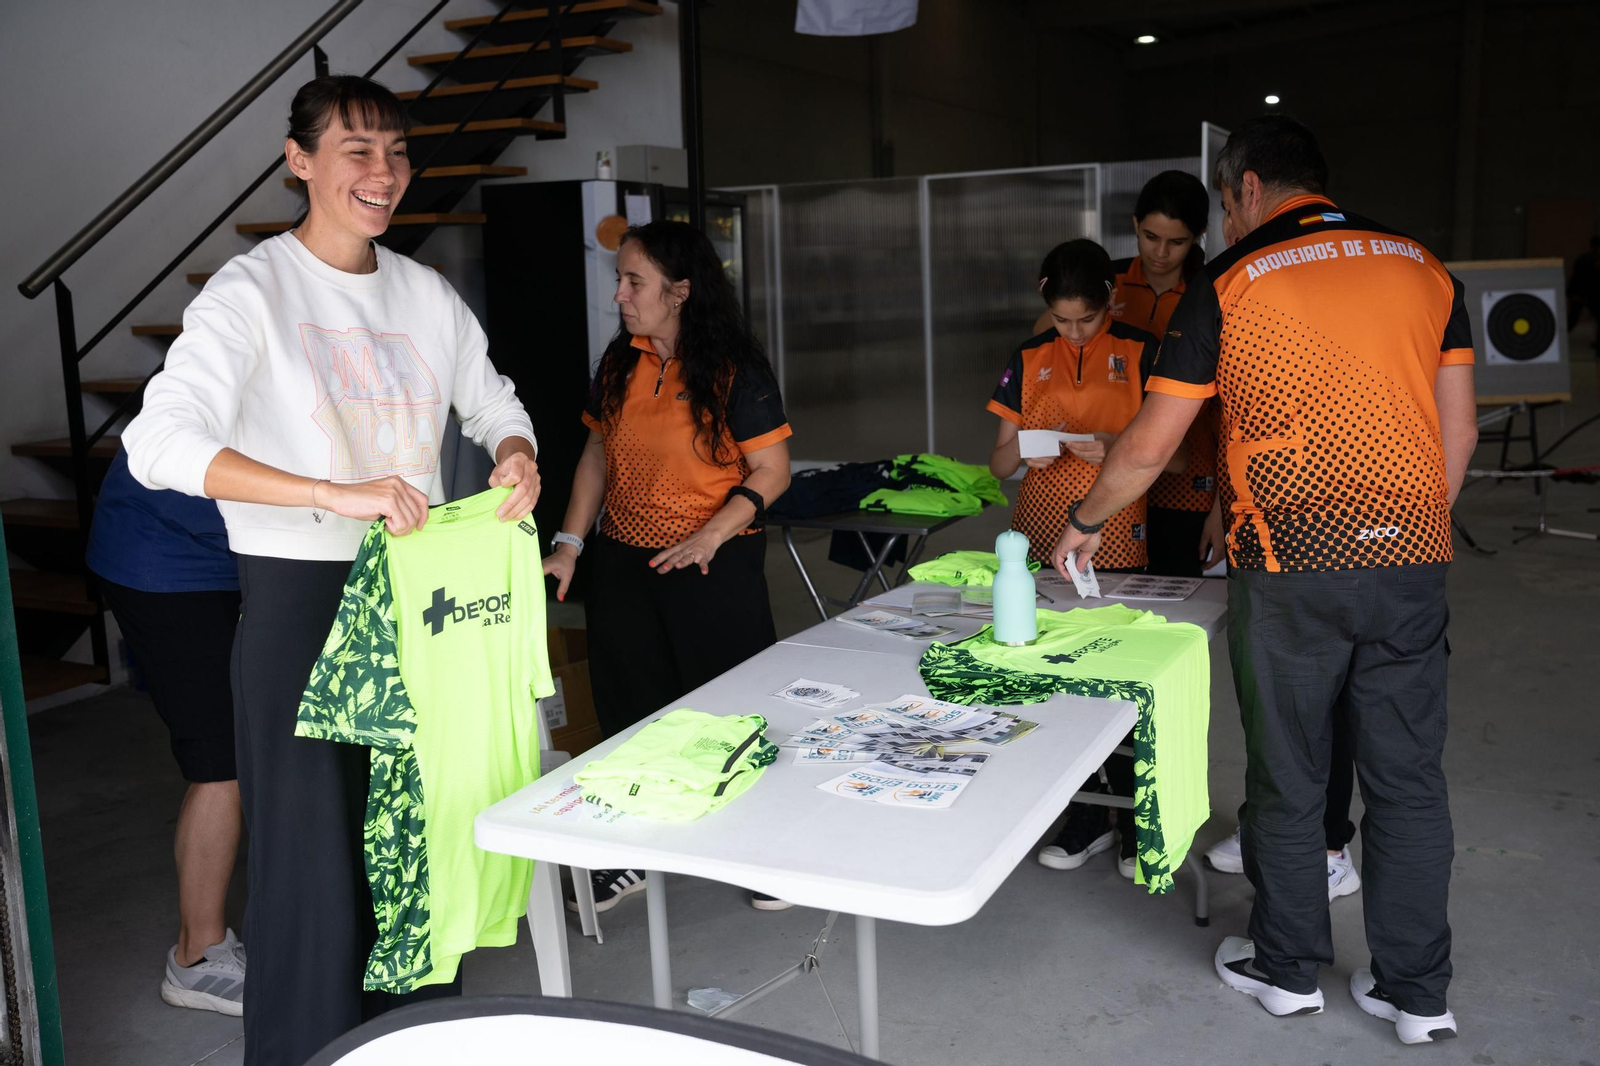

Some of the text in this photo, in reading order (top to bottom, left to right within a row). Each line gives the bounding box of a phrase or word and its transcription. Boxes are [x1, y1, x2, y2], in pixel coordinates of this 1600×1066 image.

[1246, 239, 1424, 281] ARQUEIROS DE EIROÁS
[299, 323, 441, 404] BIMBA
[452, 592, 511, 624] DEPOR
[482, 612, 511, 627] a Re
[905, 783, 959, 792] Eiroa
